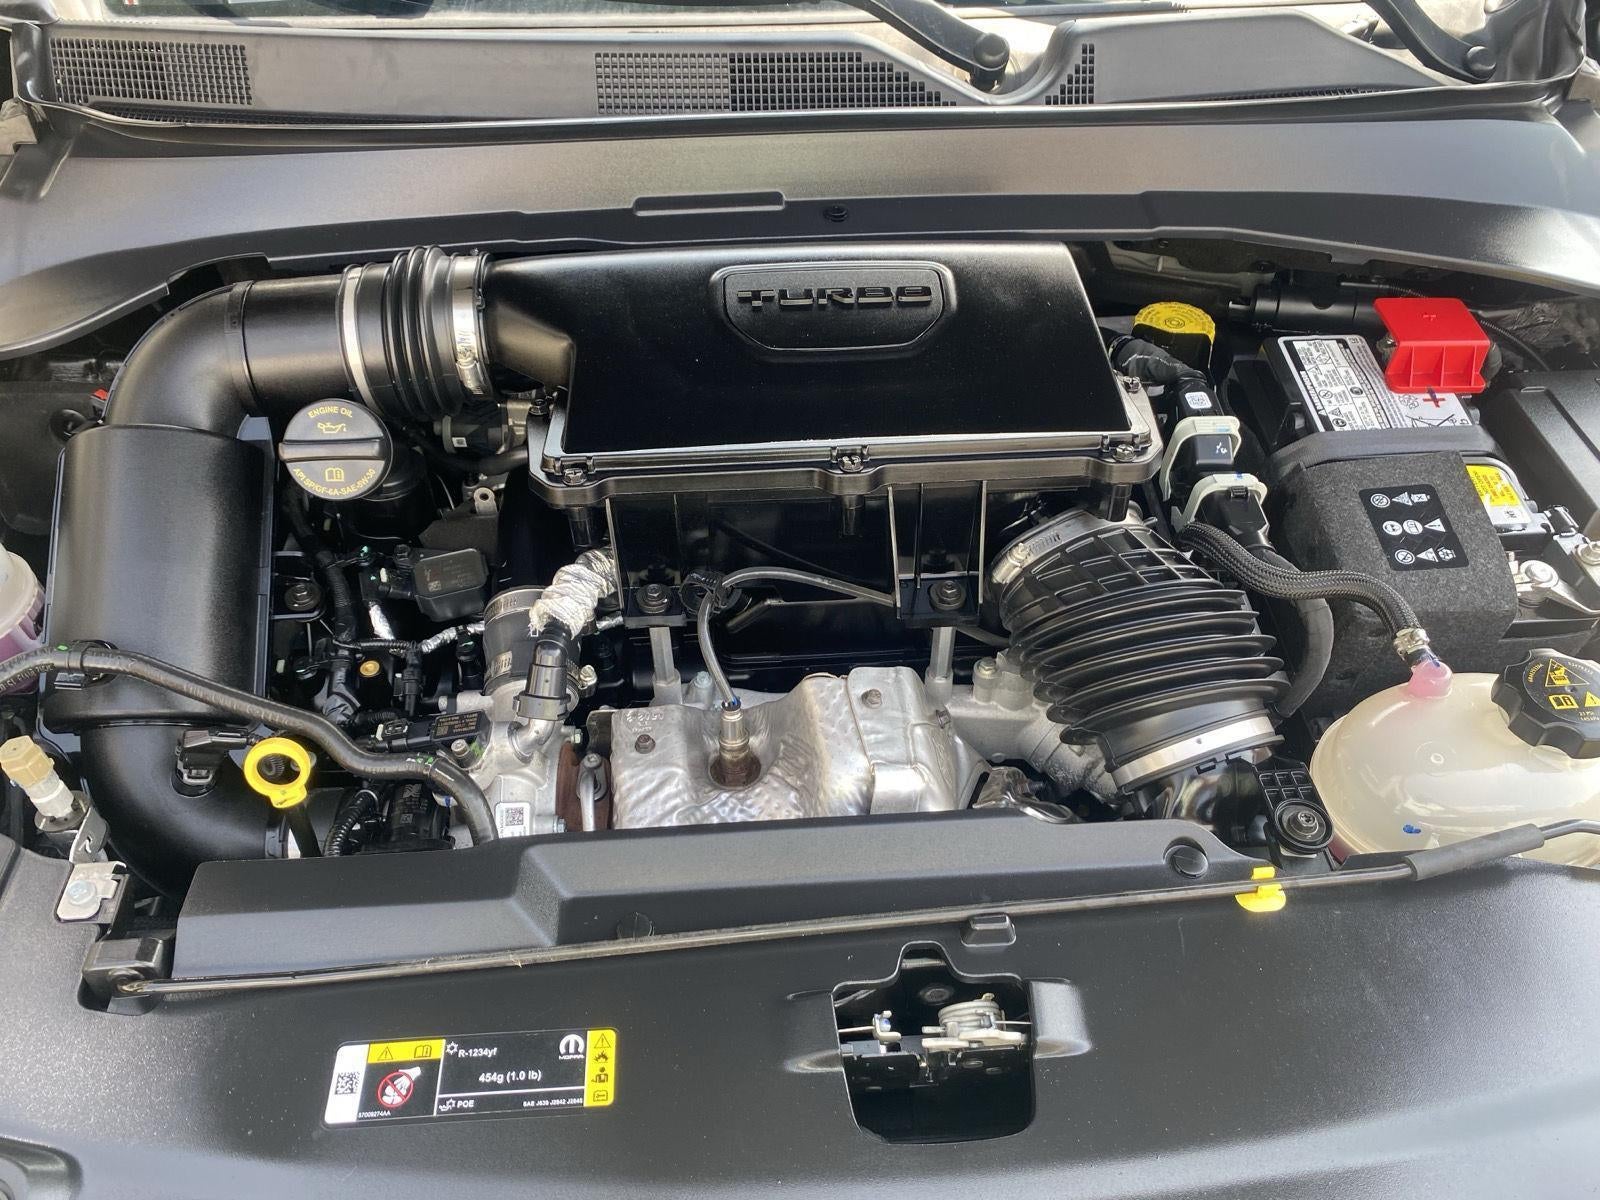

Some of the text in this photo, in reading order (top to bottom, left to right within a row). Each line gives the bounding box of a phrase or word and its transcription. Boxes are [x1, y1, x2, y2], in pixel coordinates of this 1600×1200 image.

[736, 285, 932, 308] TURBO
[307, 406, 353, 418] ENGINE OIL
[293, 468, 304, 481] API
[458, 1047, 498, 1059] R-1234yf
[478, 1069, 542, 1084] 454g (1.0 lb)
[457, 1100, 475, 1108] POE
